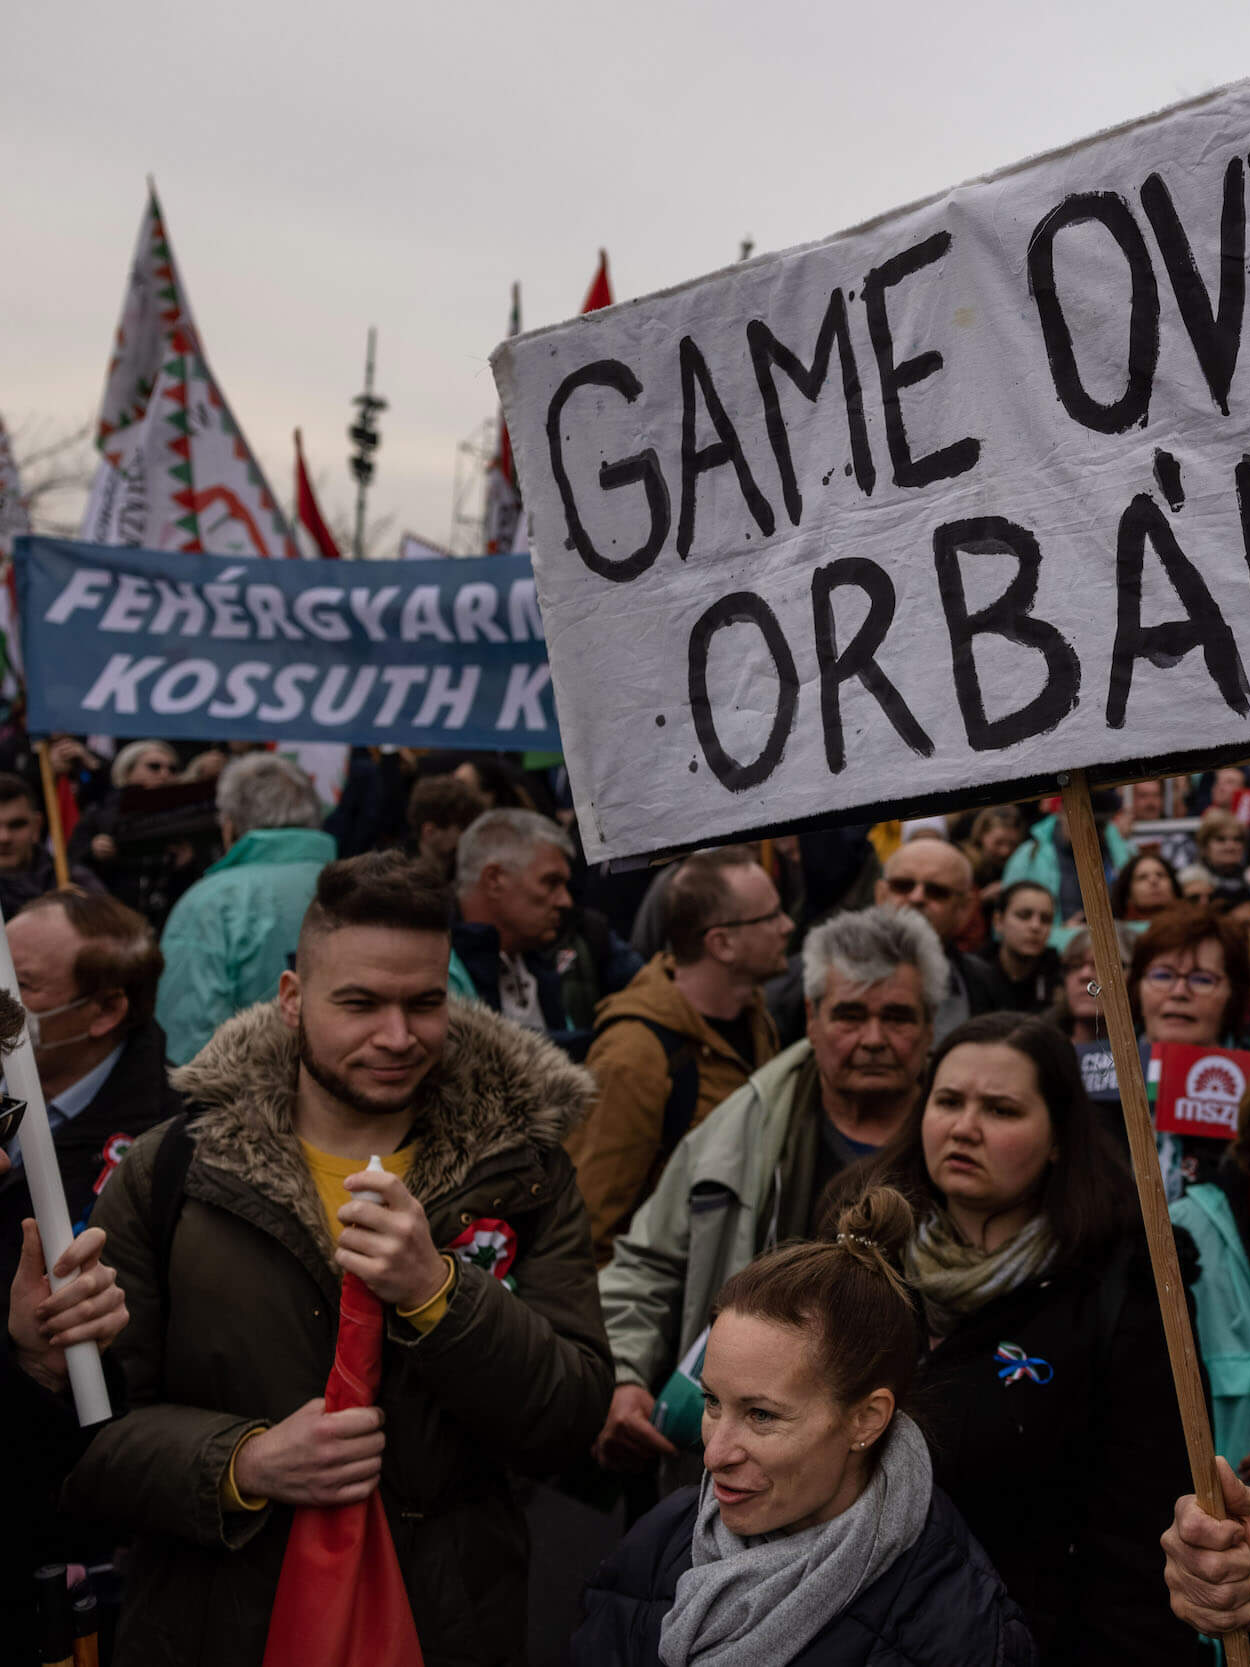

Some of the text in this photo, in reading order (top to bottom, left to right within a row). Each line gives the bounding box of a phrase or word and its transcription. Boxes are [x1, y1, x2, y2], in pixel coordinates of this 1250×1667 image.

[546, 230, 981, 582] GAME
[81, 653, 558, 731] KOSSUTH K
